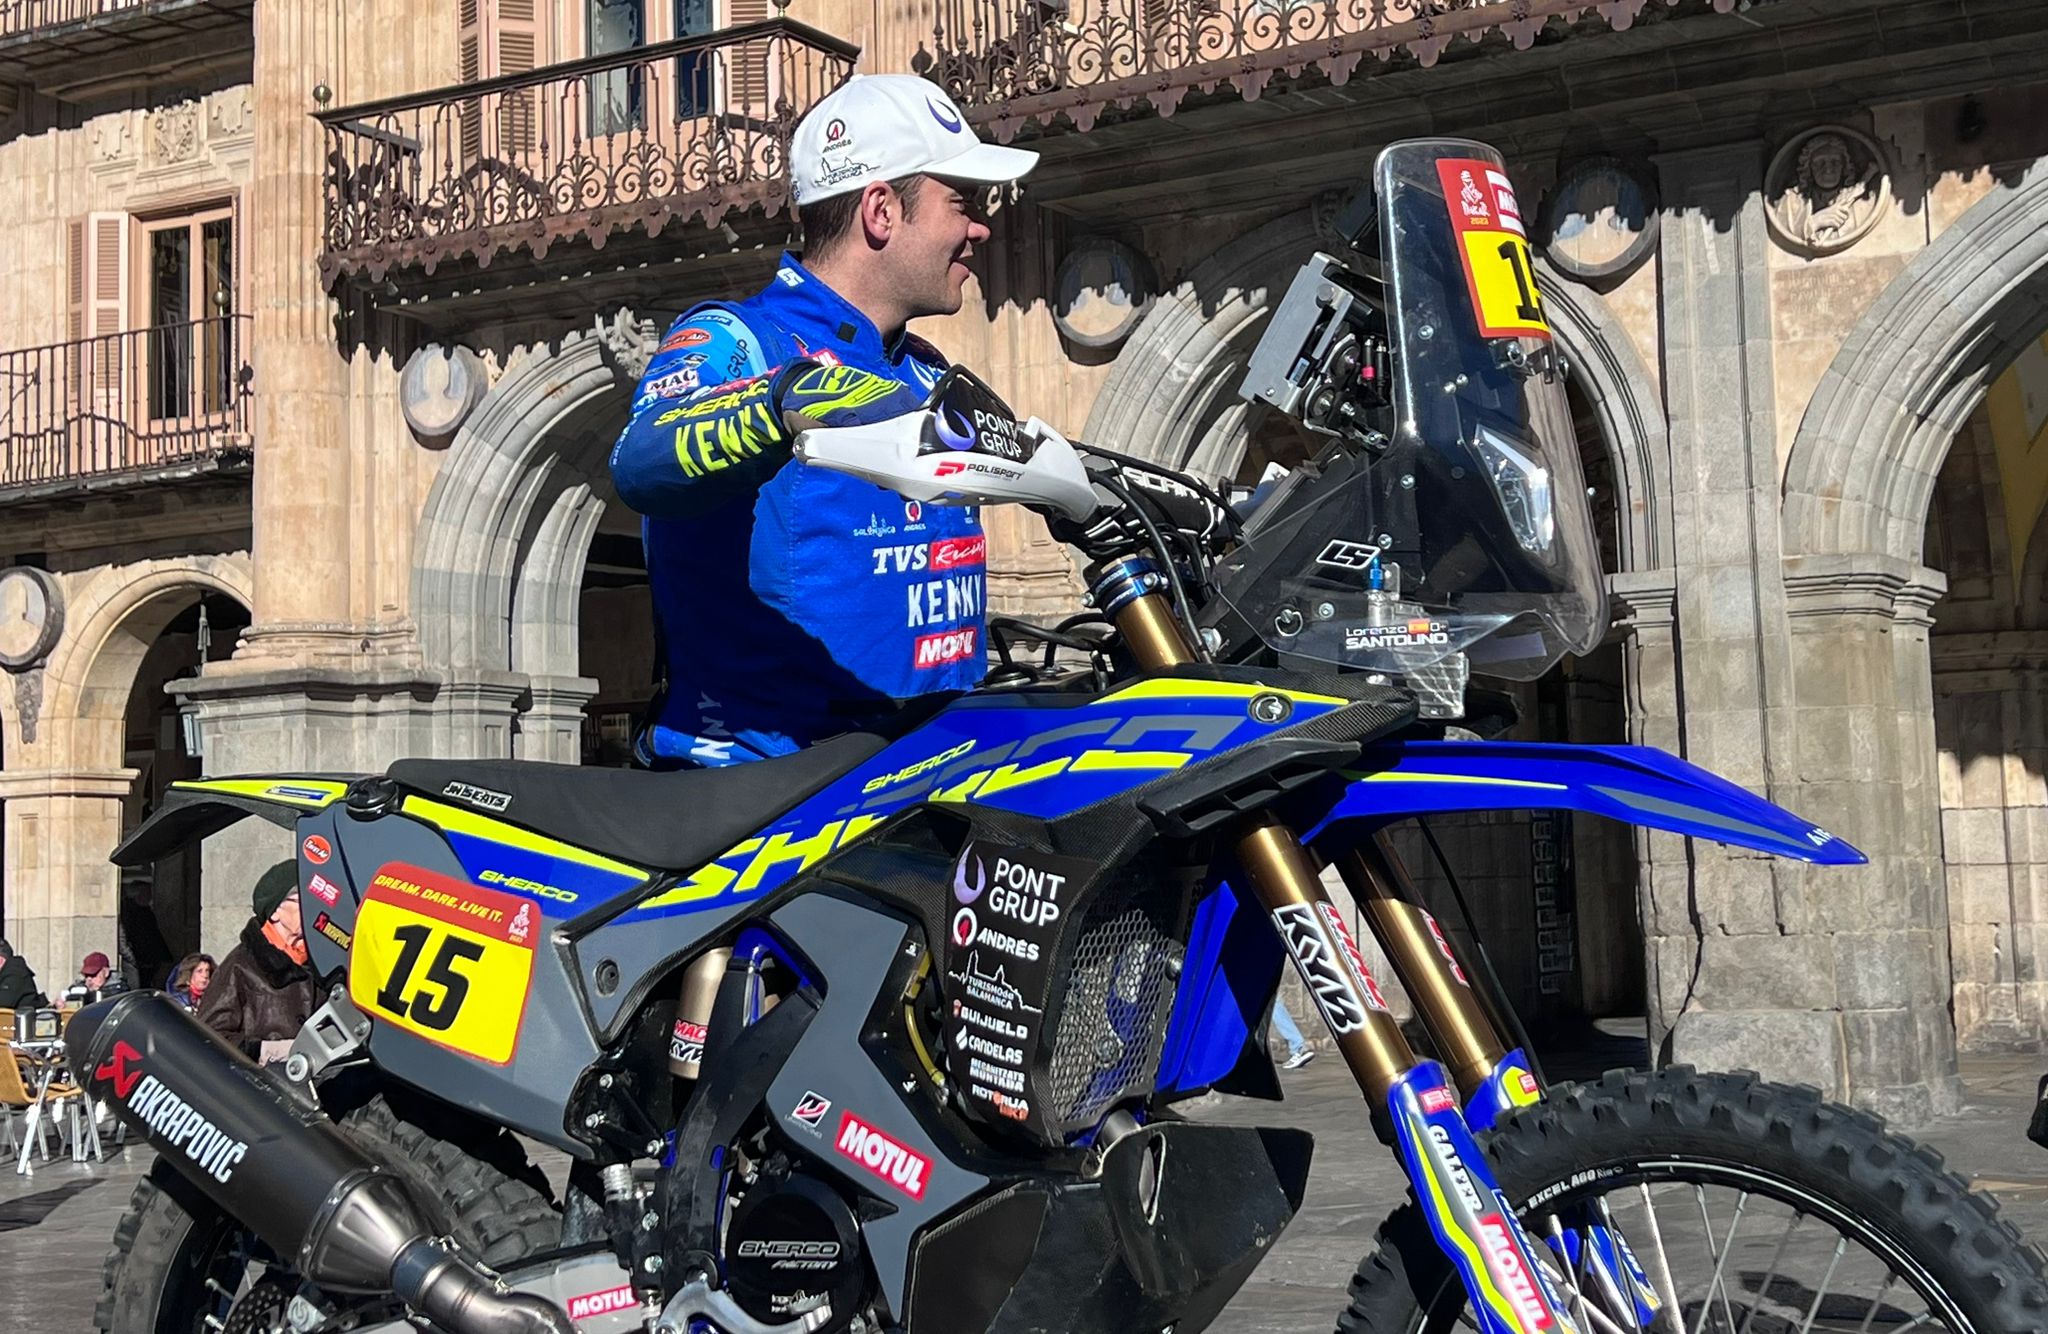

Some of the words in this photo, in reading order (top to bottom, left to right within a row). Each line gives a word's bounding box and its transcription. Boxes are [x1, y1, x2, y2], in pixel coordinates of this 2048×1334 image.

[654, 379, 769, 426] SHERC
[974, 408, 1016, 440] PONT
[980, 431, 1022, 459] GRUP
[873, 544, 928, 574] TVS
[908, 574, 982, 627] KENNY
[1346, 617, 1407, 637] Lorenzo
[1346, 632, 1448, 650] SANTOLINO
[863, 738, 976, 793] SHERCO
[310, 874, 339, 900] BS
[478, 869, 579, 902] SHERCO
[994, 858, 1065, 900] PONT
[374, 875, 420, 896] DREAM.
[459, 900, 490, 918] LIVE
[988, 886, 1060, 927] GRUP
[377, 924, 485, 1031] 15
[966, 985, 1014, 1011] SALAMANCA
[968, 1034, 1024, 1065] CANDELAS
[838, 1120, 925, 1194] MOTUL
[1528, 1181, 1570, 1209] EXCEL
[739, 1240, 840, 1258] SHERCO
[572, 1286, 636, 1318] MOTUL
